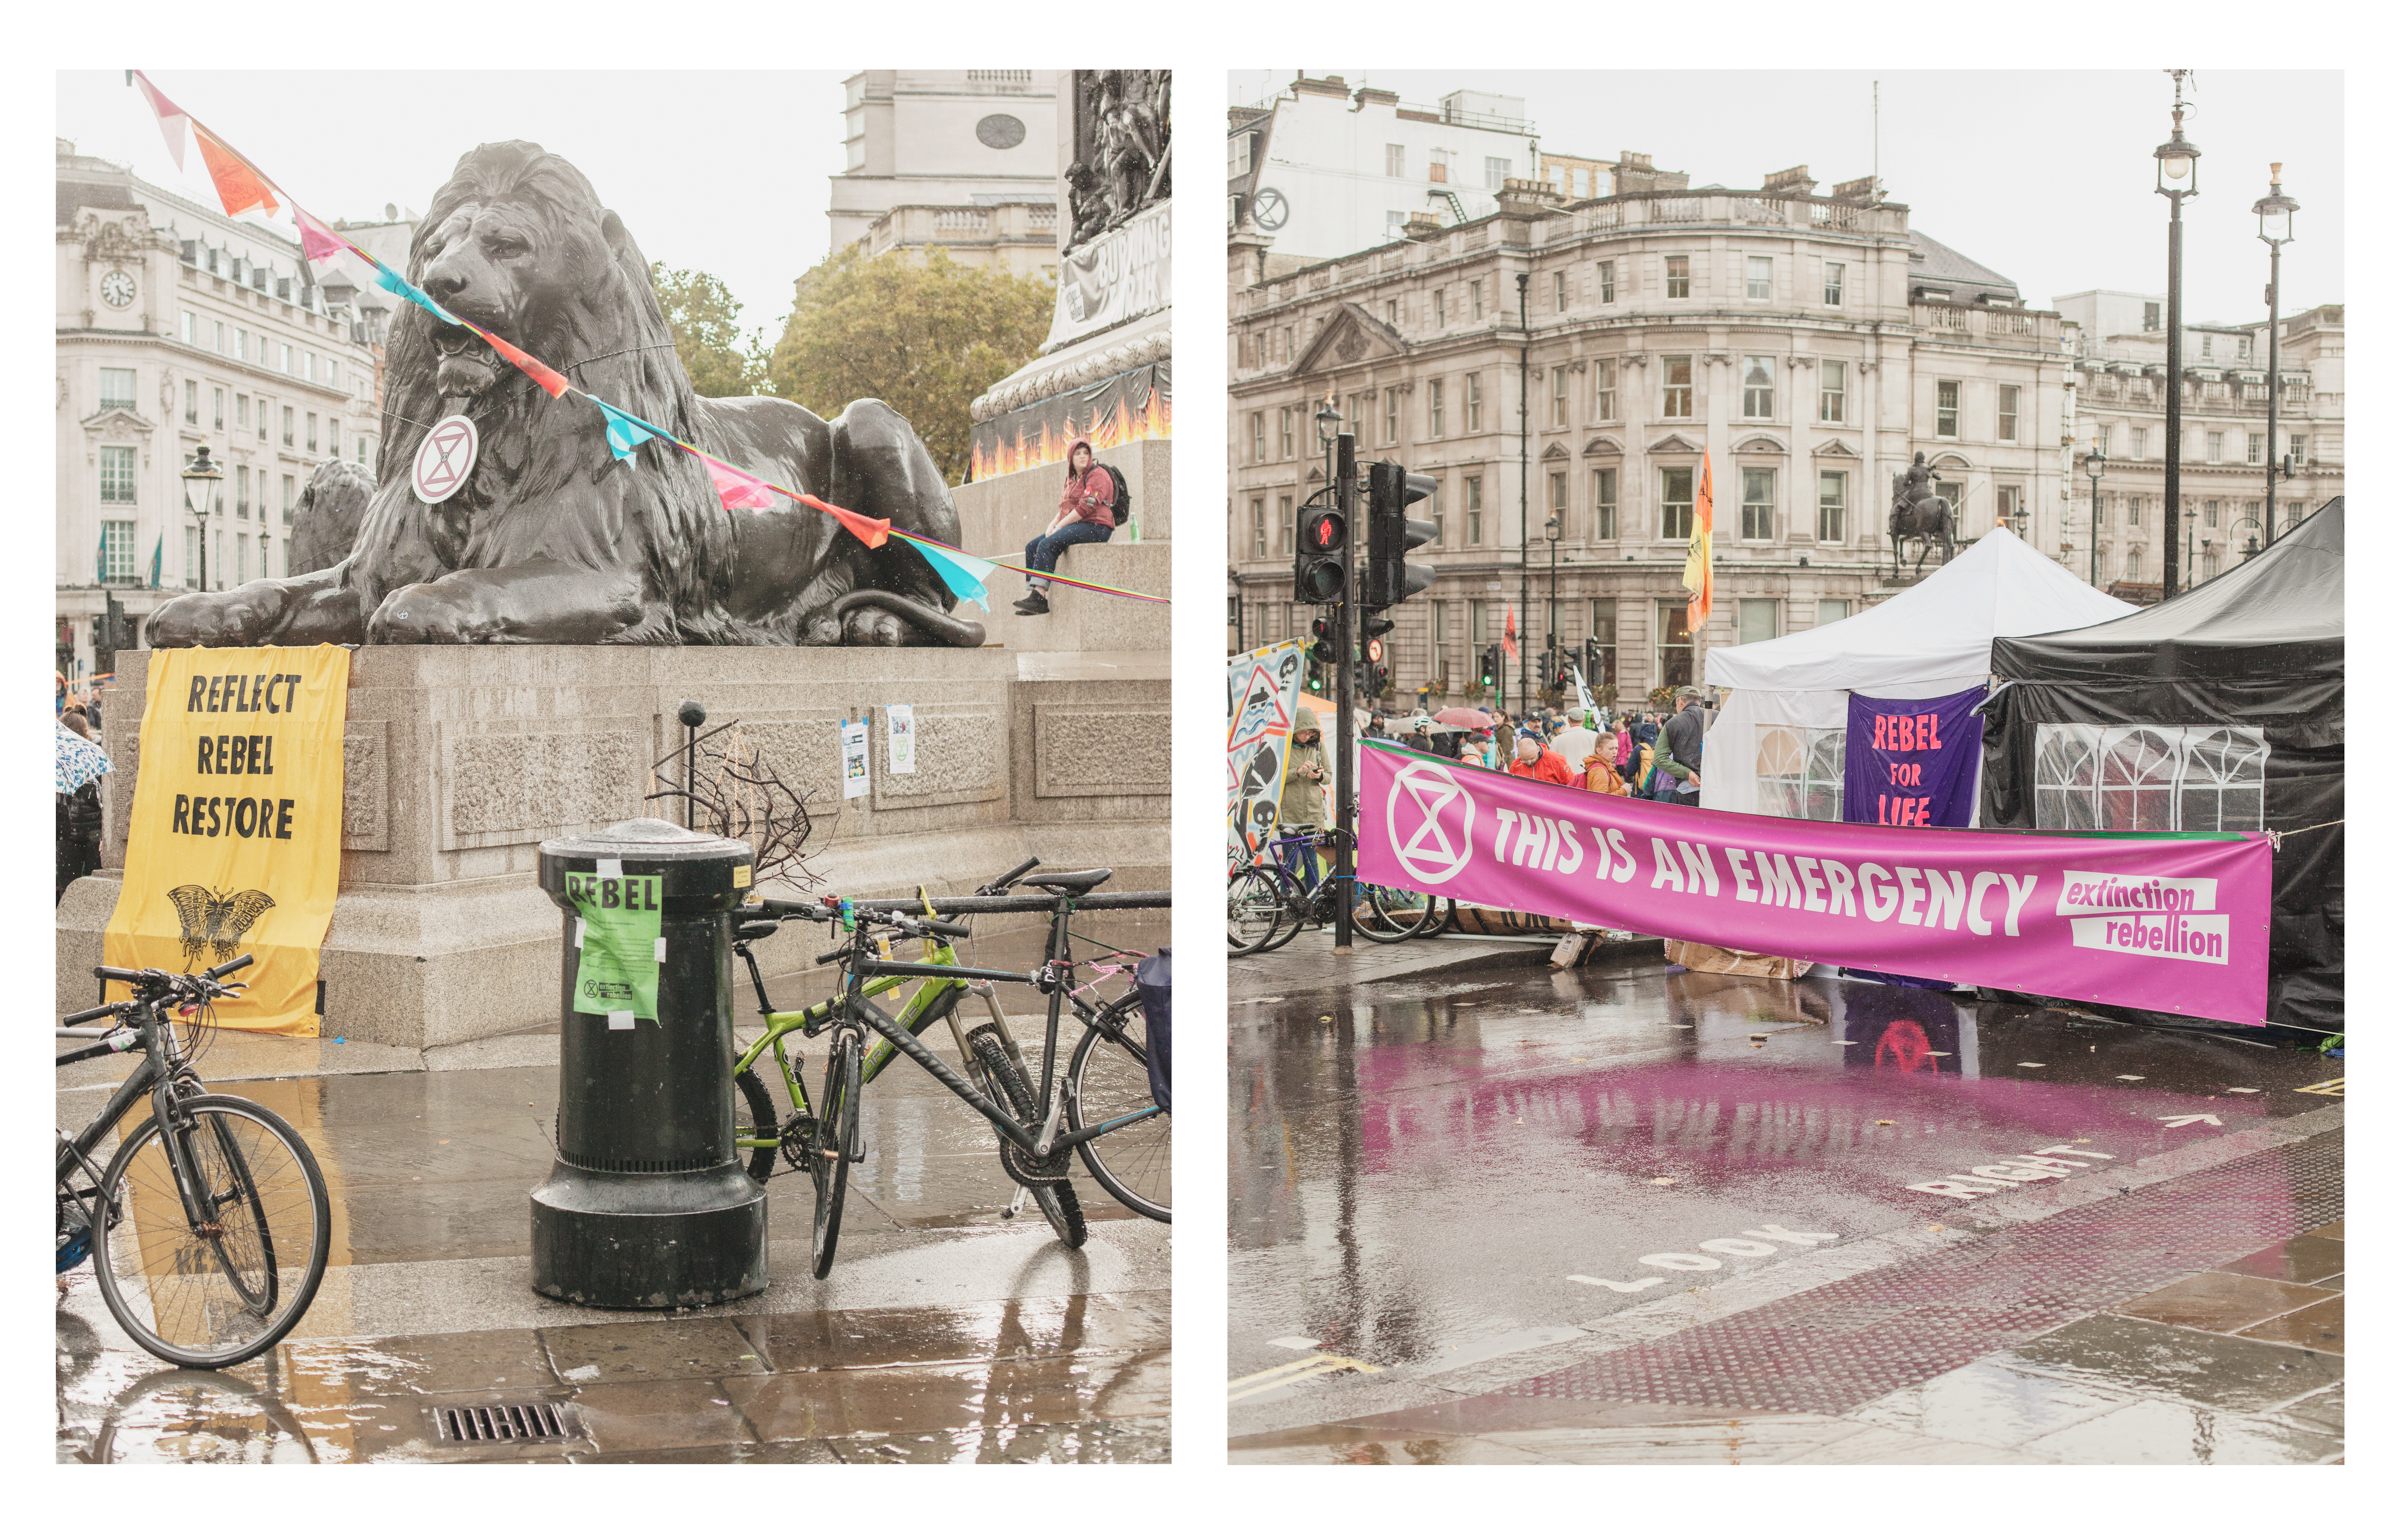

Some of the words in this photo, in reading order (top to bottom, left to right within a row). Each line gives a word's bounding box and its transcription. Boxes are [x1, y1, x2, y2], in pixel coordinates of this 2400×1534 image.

[187, 673, 302, 714] REFLECT
[1872, 713, 1942, 752] REBEL
[197, 735, 274, 775] REBEL
[1890, 763, 1922, 787] FOR
[172, 794, 295, 840] RESTORE
[1878, 794, 1932, 828] LIFE
[1494, 807, 1584, 875] THIS
[1591, 827, 1637, 883] IS
[1650, 837, 1720, 897] AN
[1724, 846, 2039, 938] EMERGENCY
[568, 875, 659, 911] REBEL
[2066, 876, 2195, 911] extinction
[2106, 914, 2223, 958] rebellion
[606, 989, 632, 999] rebellion
[862, 1004, 920, 1075] ORAGE
[1566, 1224, 1840, 1293] LOOK
[1905, 1145, 2117, 1200] RIGHT
